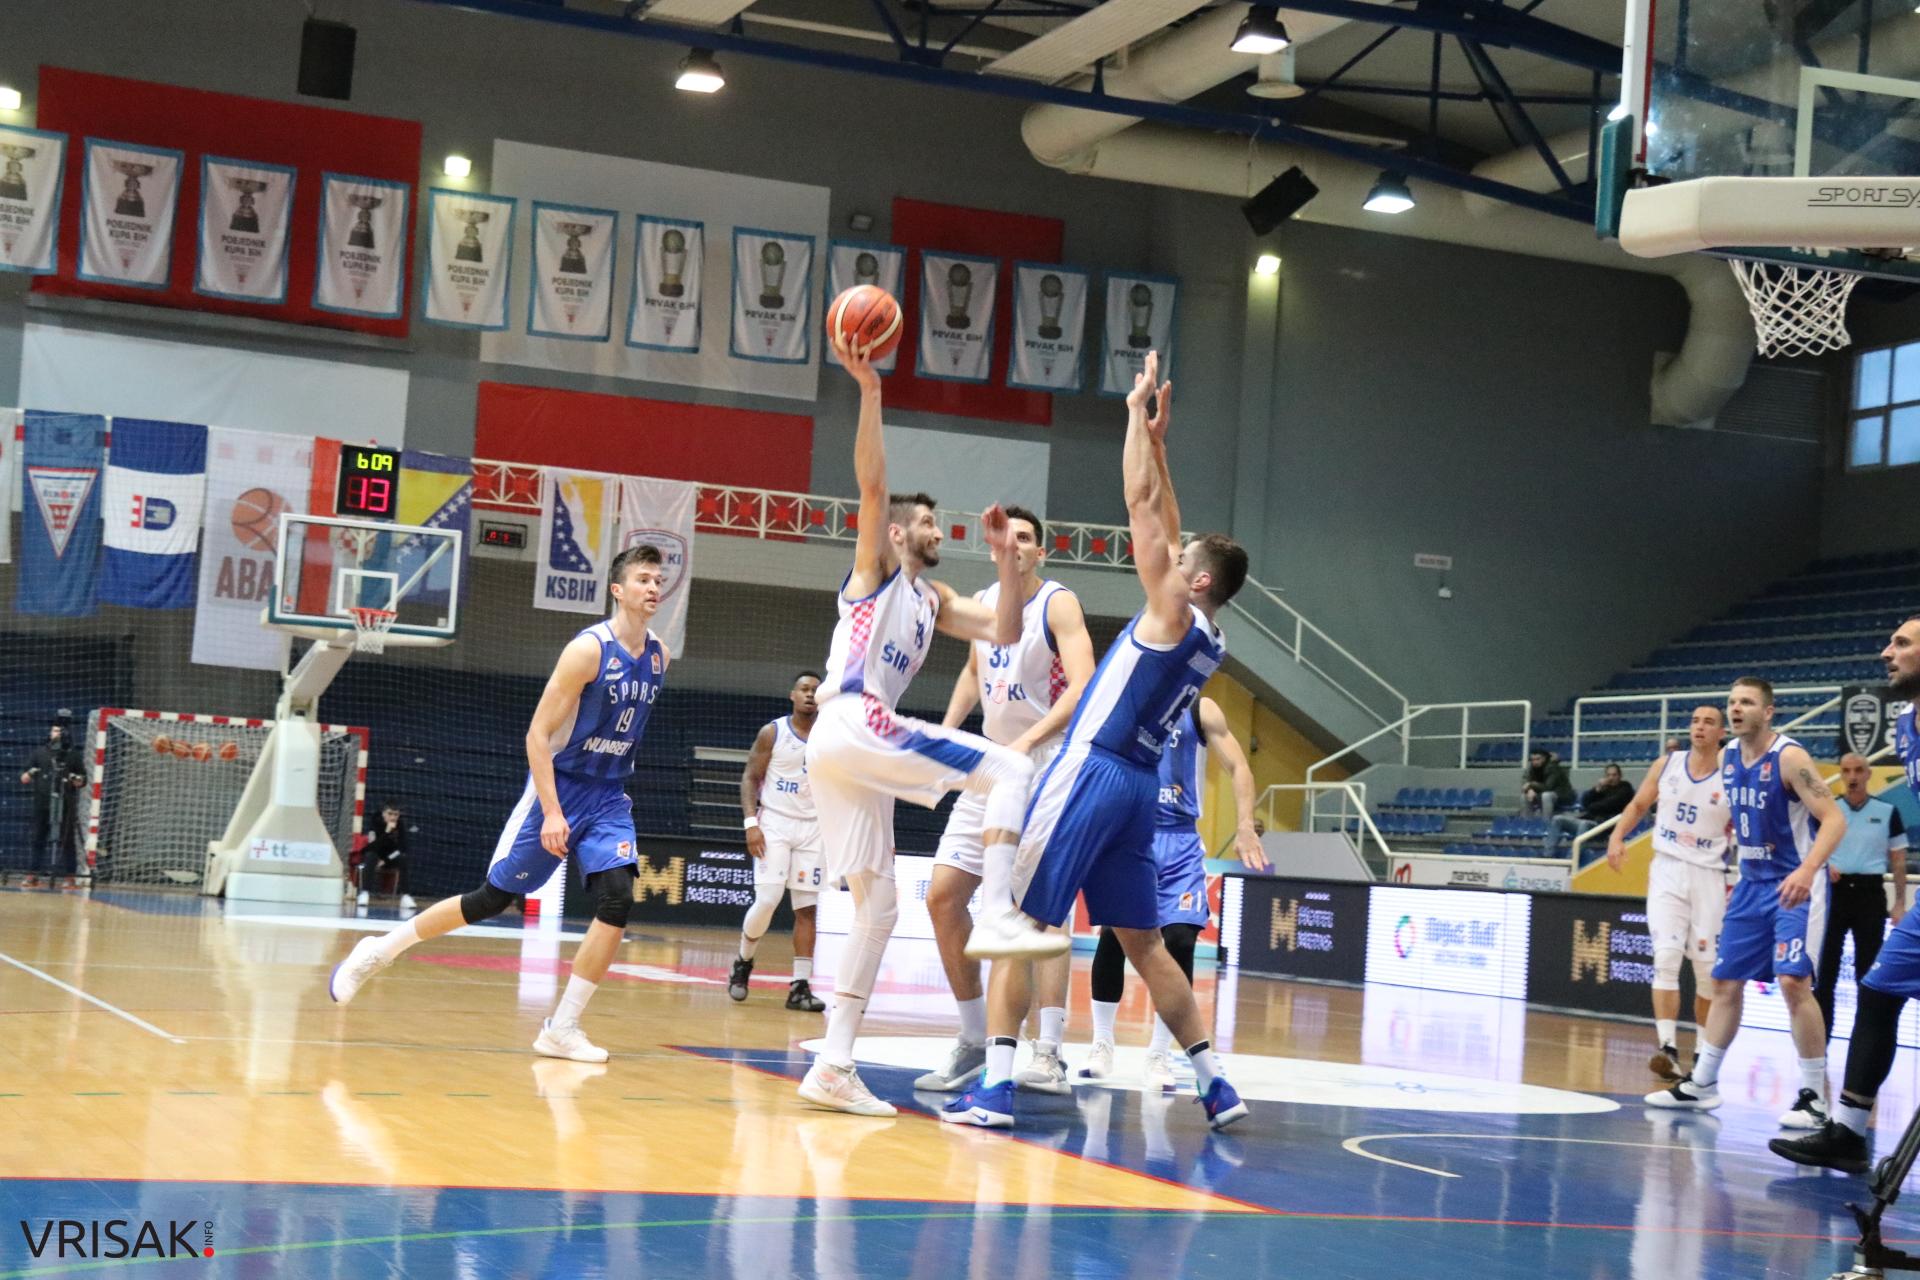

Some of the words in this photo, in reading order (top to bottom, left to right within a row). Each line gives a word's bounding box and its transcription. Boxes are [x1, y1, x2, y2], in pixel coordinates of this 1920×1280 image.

[360, 478, 390, 512] 13
[545, 575, 597, 602] KSBIH
[608, 680, 659, 704] SPARS
[615, 707, 635, 732] 19
[1676, 802, 1698, 824] 55
[1740, 812, 1750, 837] 8
[813, 868, 821, 885] 5
[1788, 938, 1803, 963] 8
